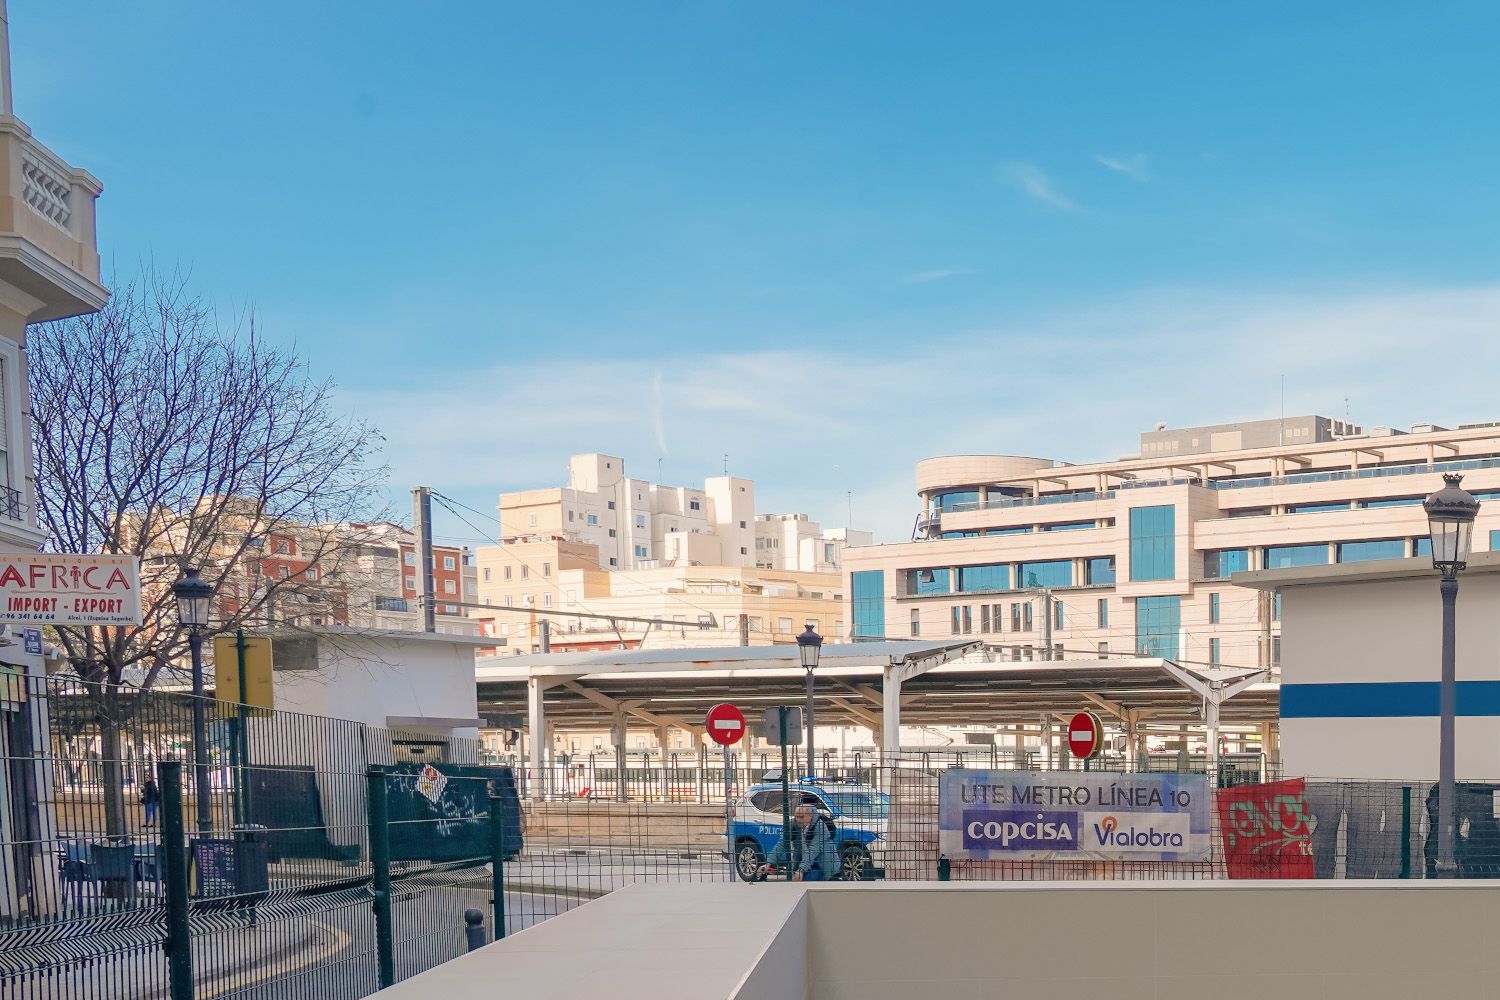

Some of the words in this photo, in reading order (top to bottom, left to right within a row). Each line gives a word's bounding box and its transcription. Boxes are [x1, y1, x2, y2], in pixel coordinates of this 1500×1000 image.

[8, 597, 58, 612] IMPORT
[74, 598, 123, 613] EXPORT
[961, 783, 1005, 804] UTE
[1012, 785, 1091, 806] METRO
[1098, 782, 1163, 807] LÍNEA
[1169, 790, 1191, 808] 10
[1094, 815, 1183, 847] Vialobra
